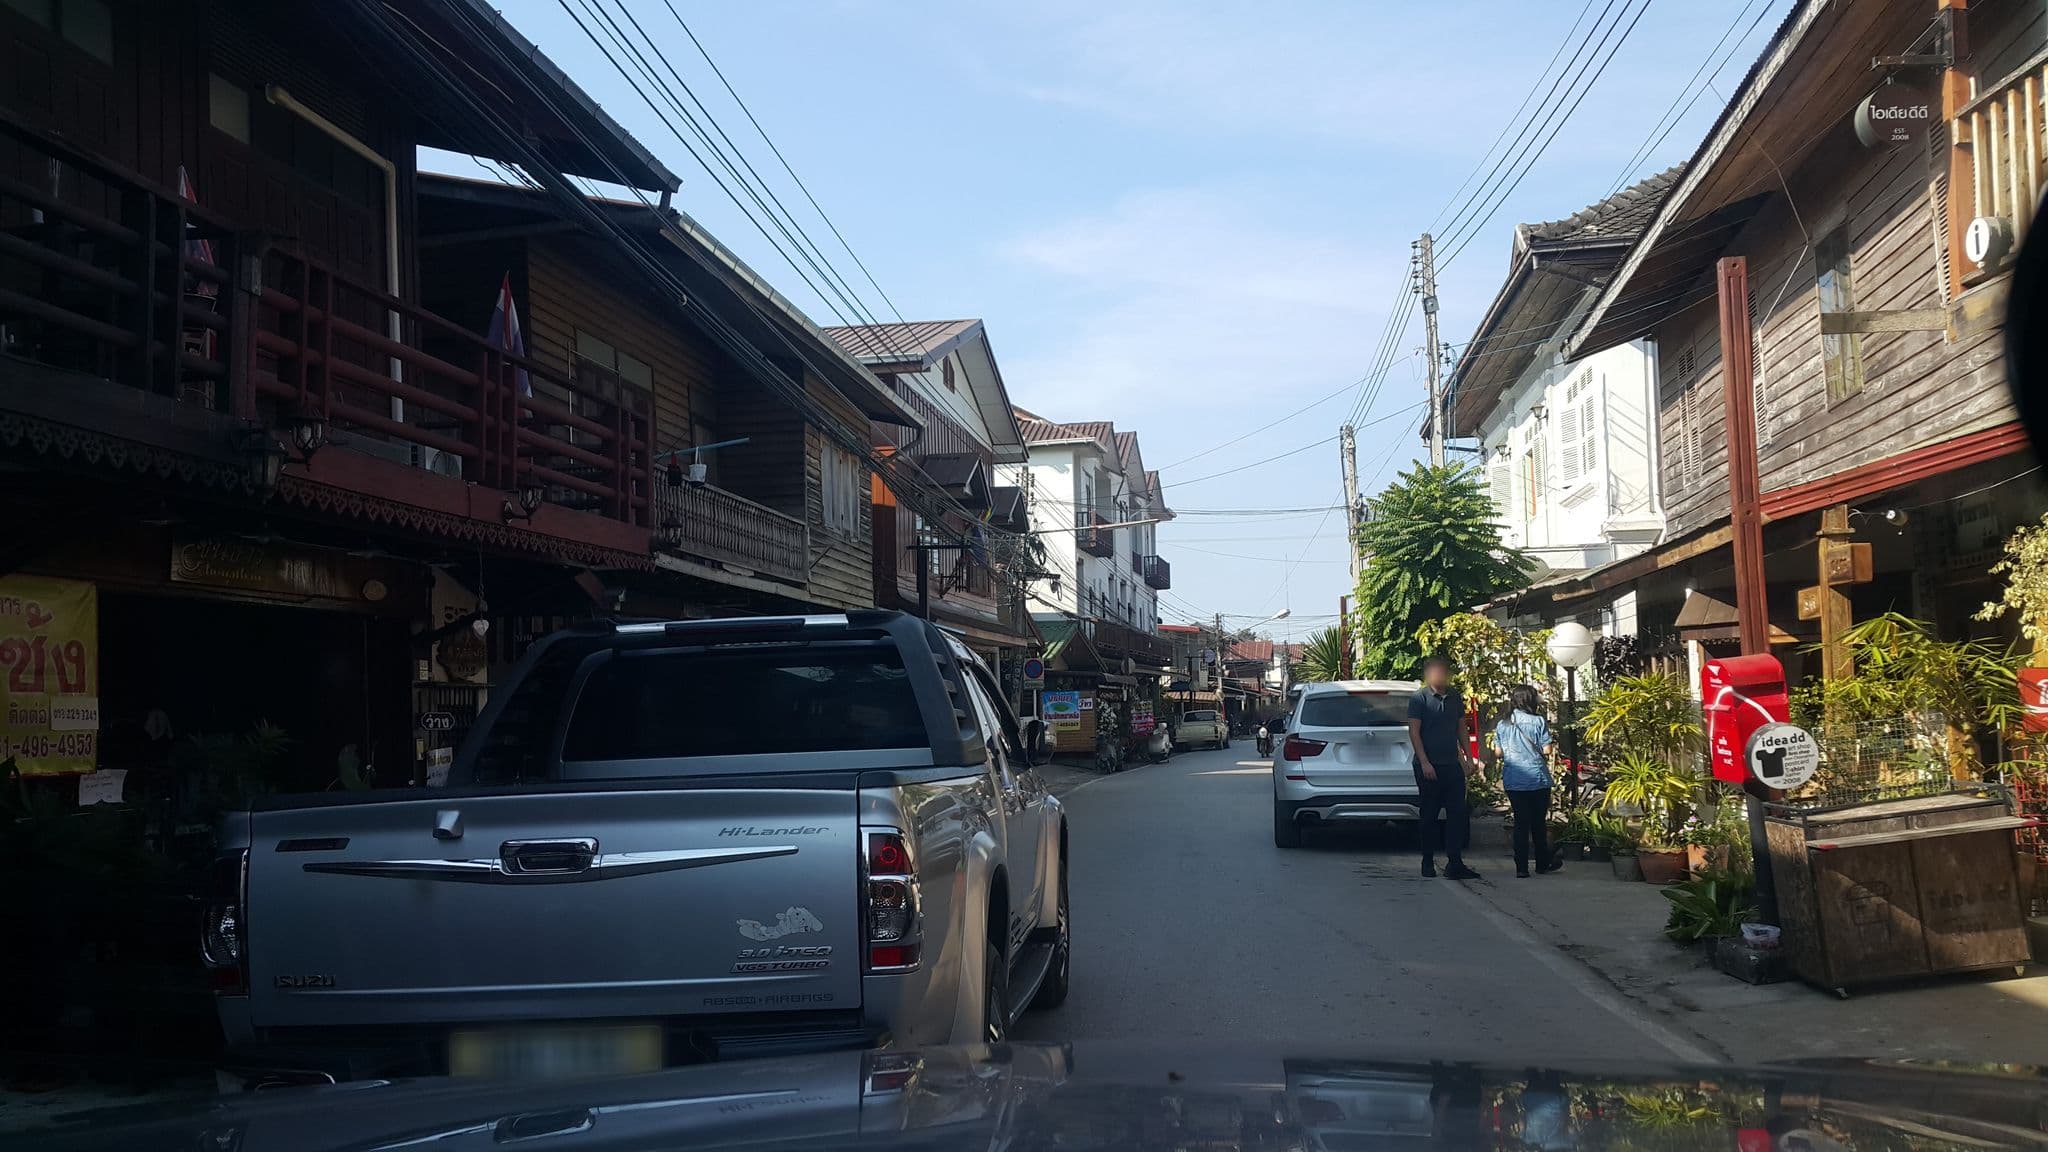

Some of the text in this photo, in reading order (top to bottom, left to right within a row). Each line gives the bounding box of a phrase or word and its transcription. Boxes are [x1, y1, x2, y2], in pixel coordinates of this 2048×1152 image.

[8, 703, 47, 725] ติดต่อ
[427, 716, 450, 728] ว่าง
[0, 734, 92, 758] 1-496-4953
[1762, 732, 1805, 747] idea dd
